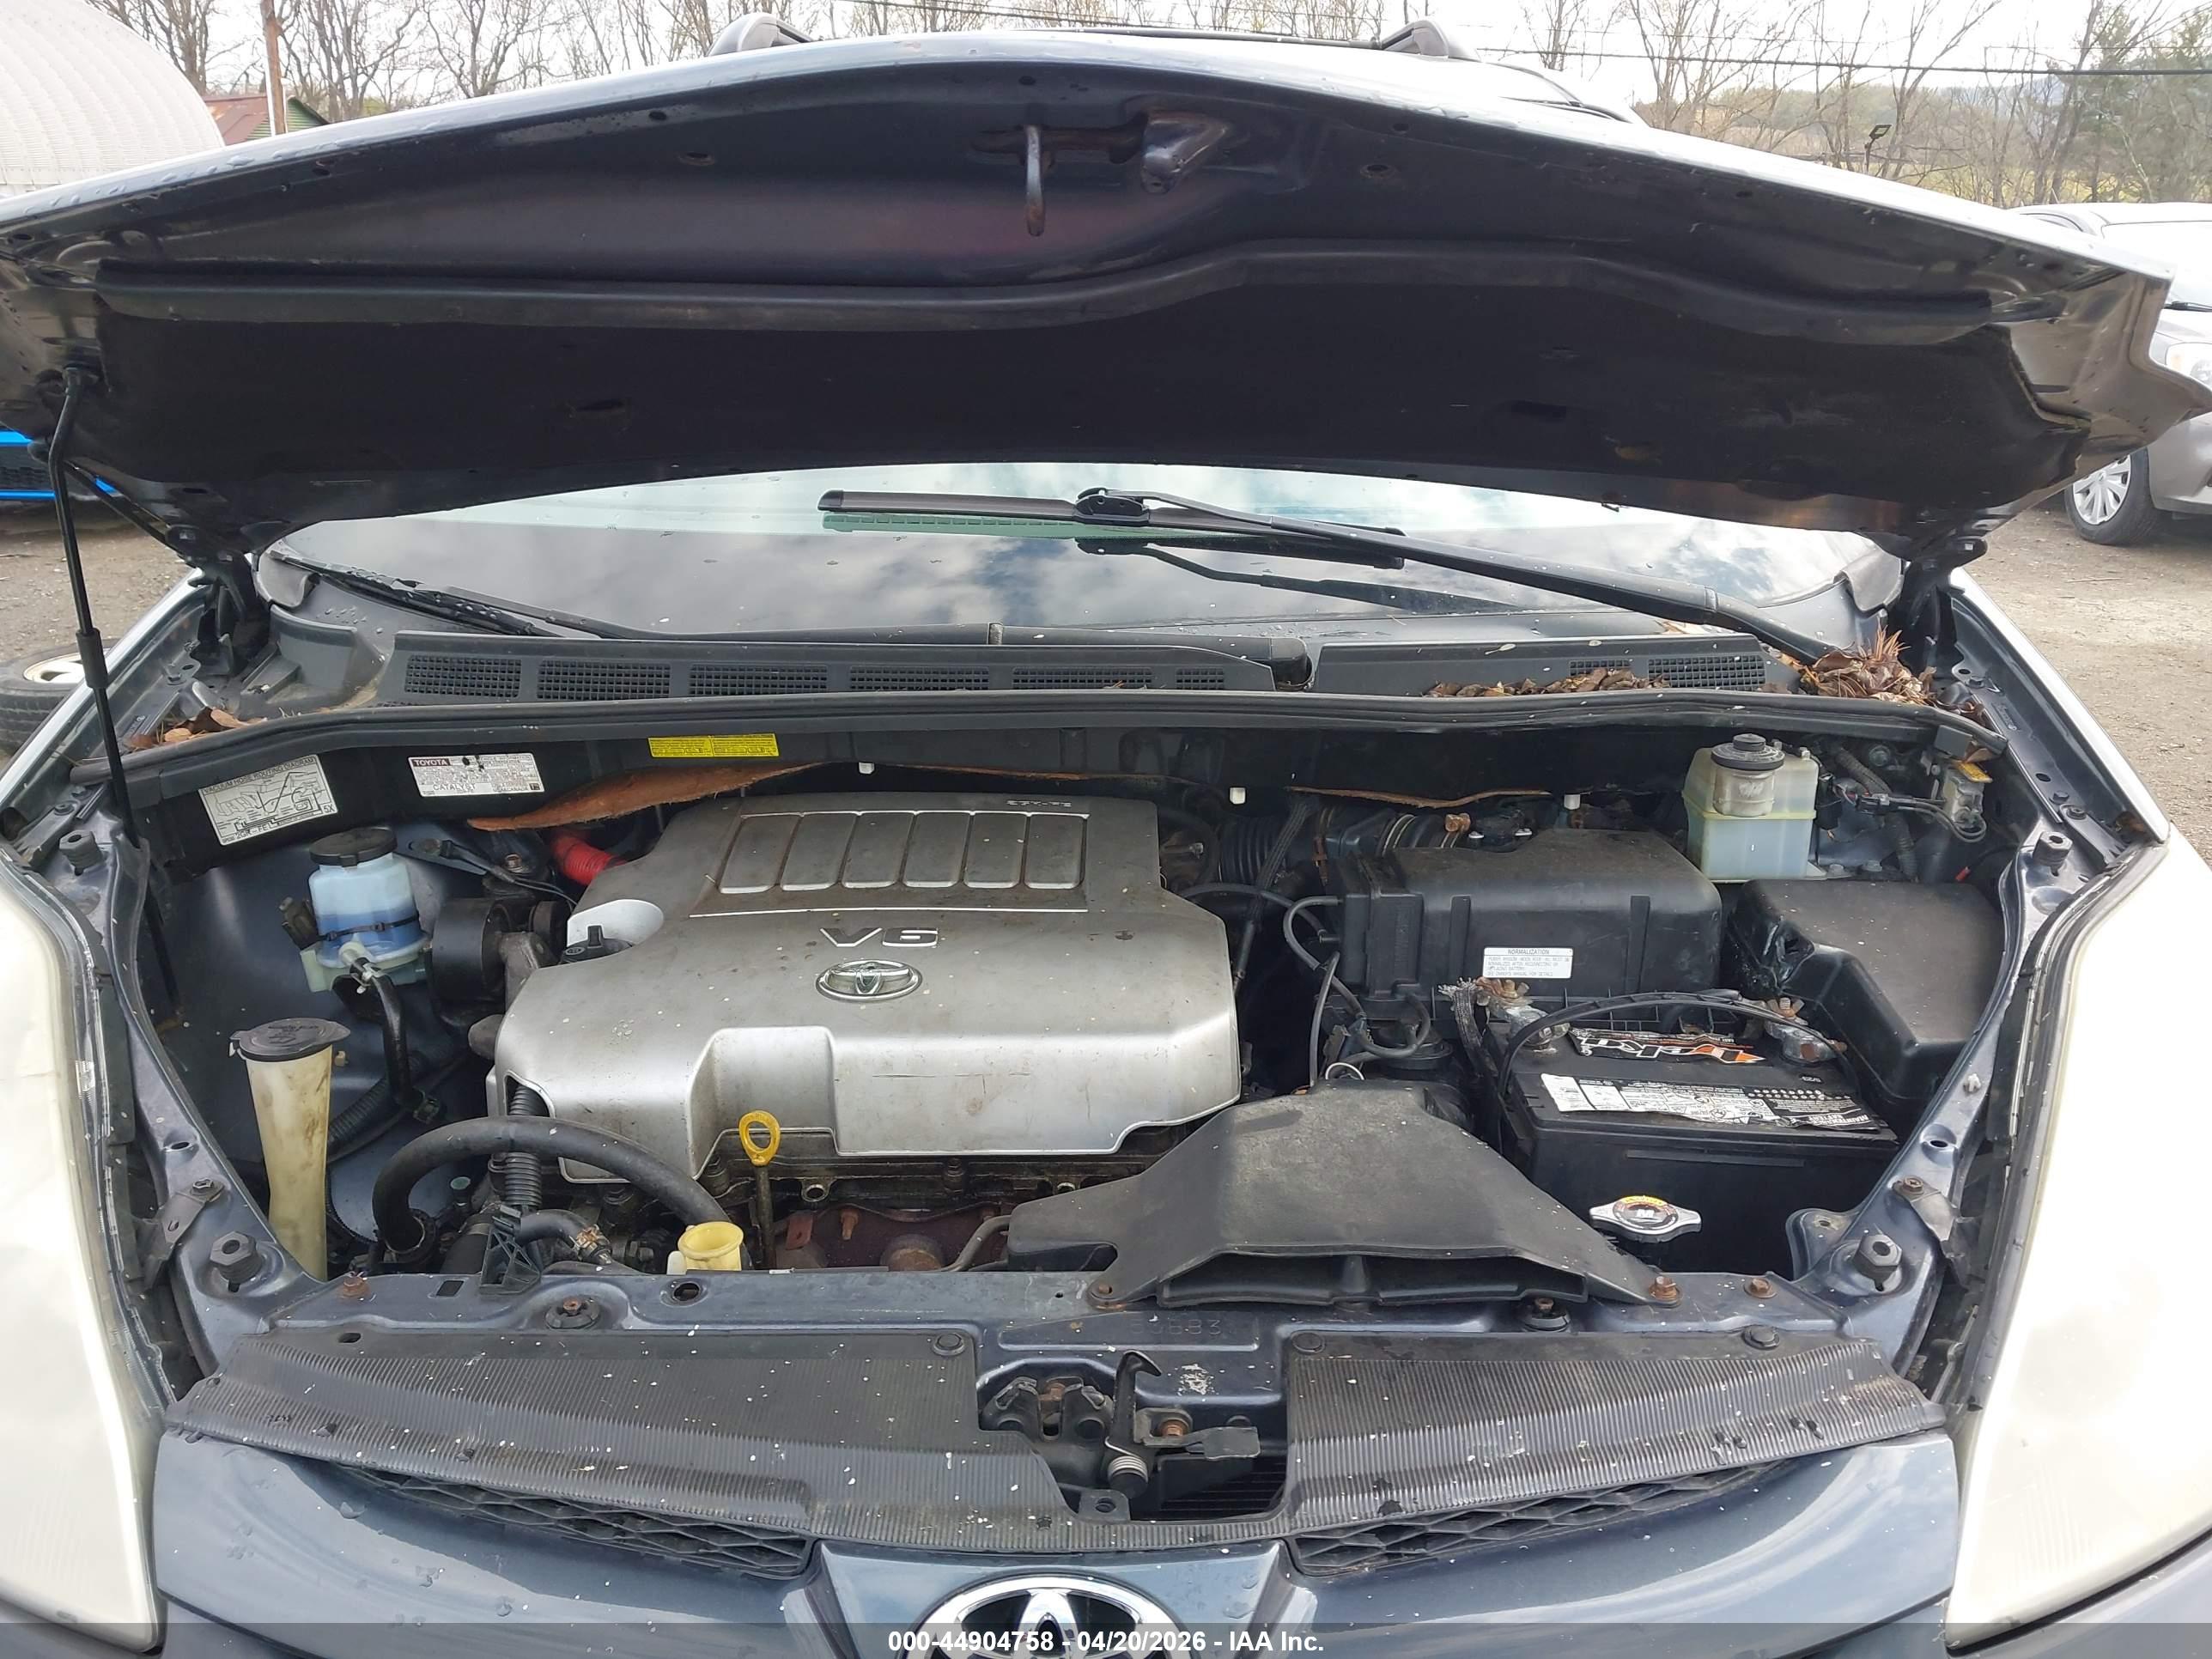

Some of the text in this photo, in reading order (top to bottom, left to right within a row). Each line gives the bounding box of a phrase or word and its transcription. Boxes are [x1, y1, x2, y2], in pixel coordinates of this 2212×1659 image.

[204, 781, 233, 793] VACUUM
[234, 775, 252, 786] HOSE
[819, 927, 939, 947] V6
